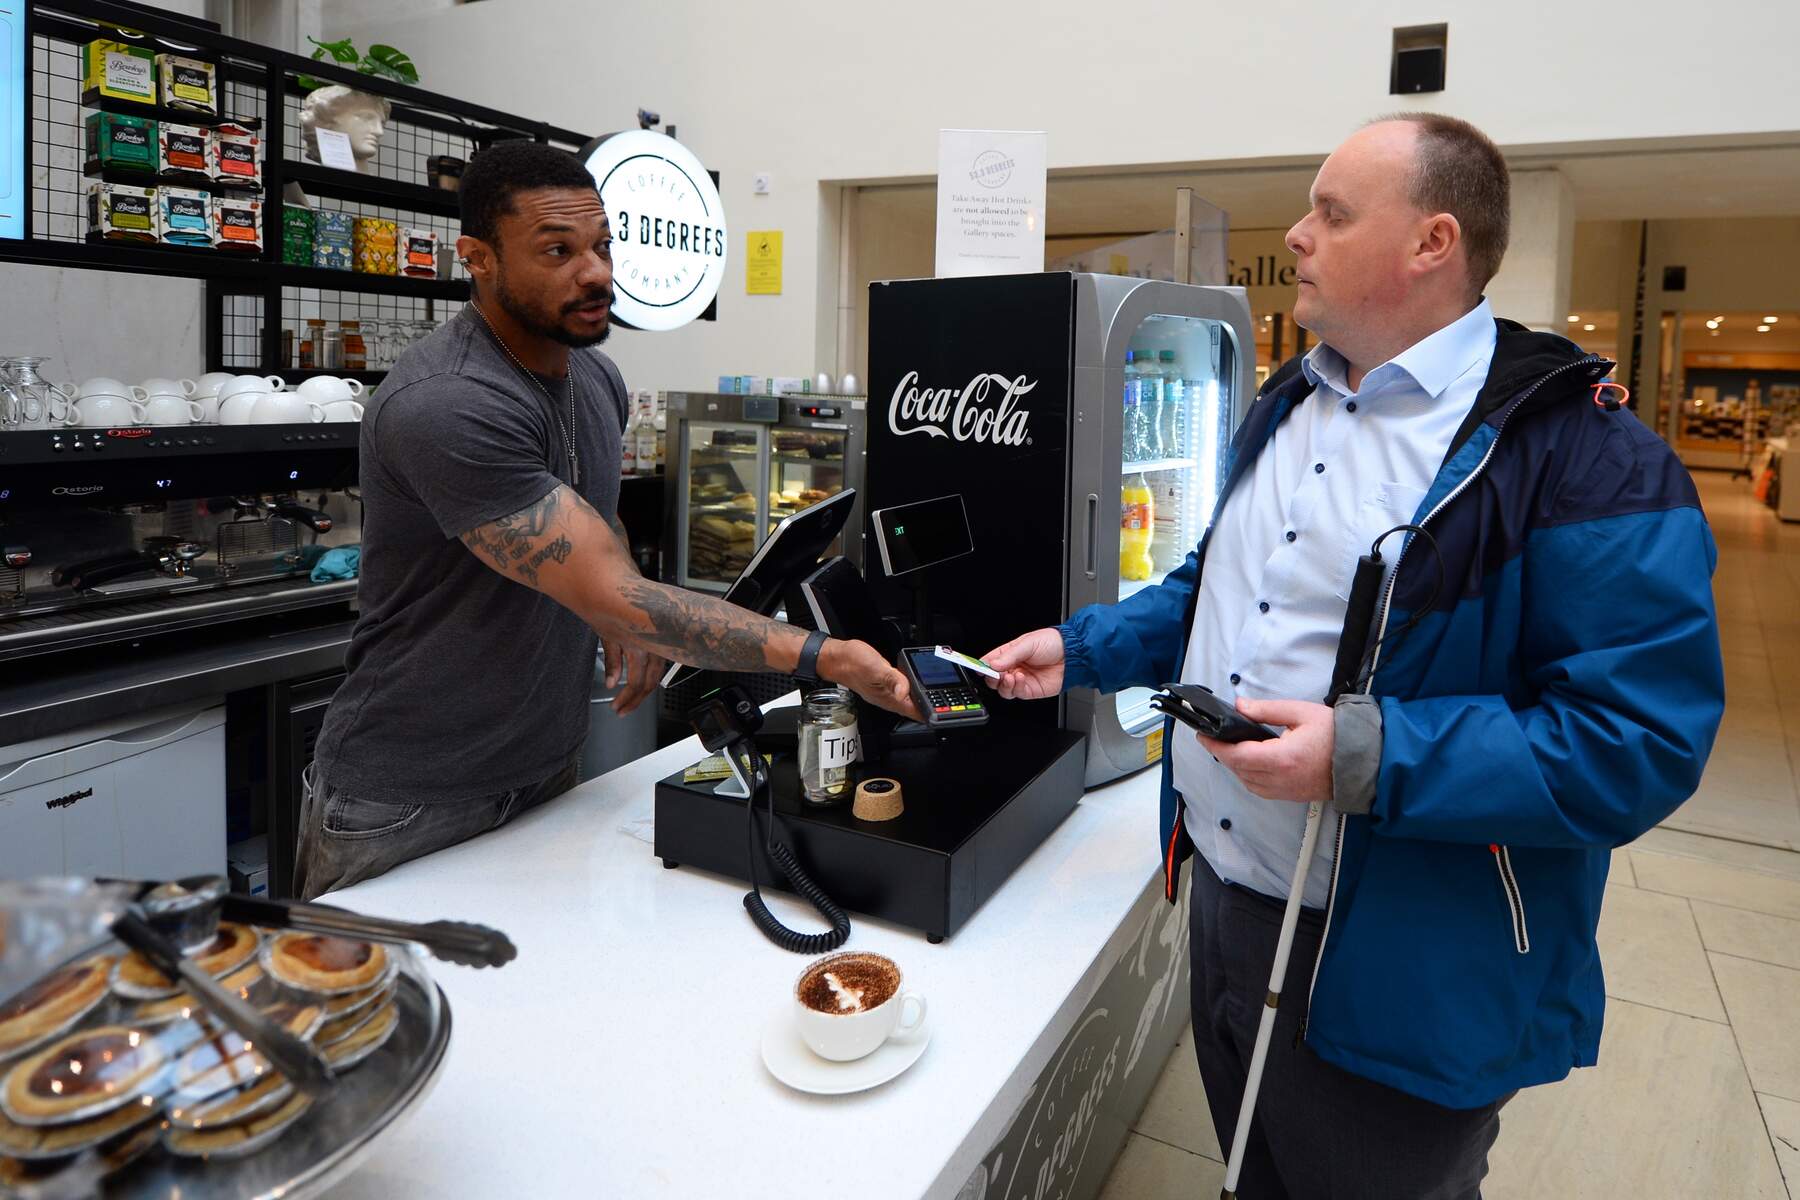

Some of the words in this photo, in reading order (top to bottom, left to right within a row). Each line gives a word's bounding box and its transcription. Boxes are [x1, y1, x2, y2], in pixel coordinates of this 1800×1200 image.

[627, 173, 685, 202] COFFEE
[952, 194, 969, 203] Take
[971, 195, 989, 205] Away
[991, 195, 1005, 204] Hot
[1006, 196, 1032, 205] Drinks
[961, 216, 990, 227] brought
[991, 217, 1007, 226] into
[1008, 219, 1021, 227] the
[965, 206, 979, 214] not
[980, 206, 1010, 216] allowed
[640, 214, 723, 257] DEGREES
[963, 228, 990, 239] Gallery
[621, 259, 689, 290] COMPANY
[888, 371, 1039, 447] Coca-Cola
[46, 787, 92, 809] Whirlpool
